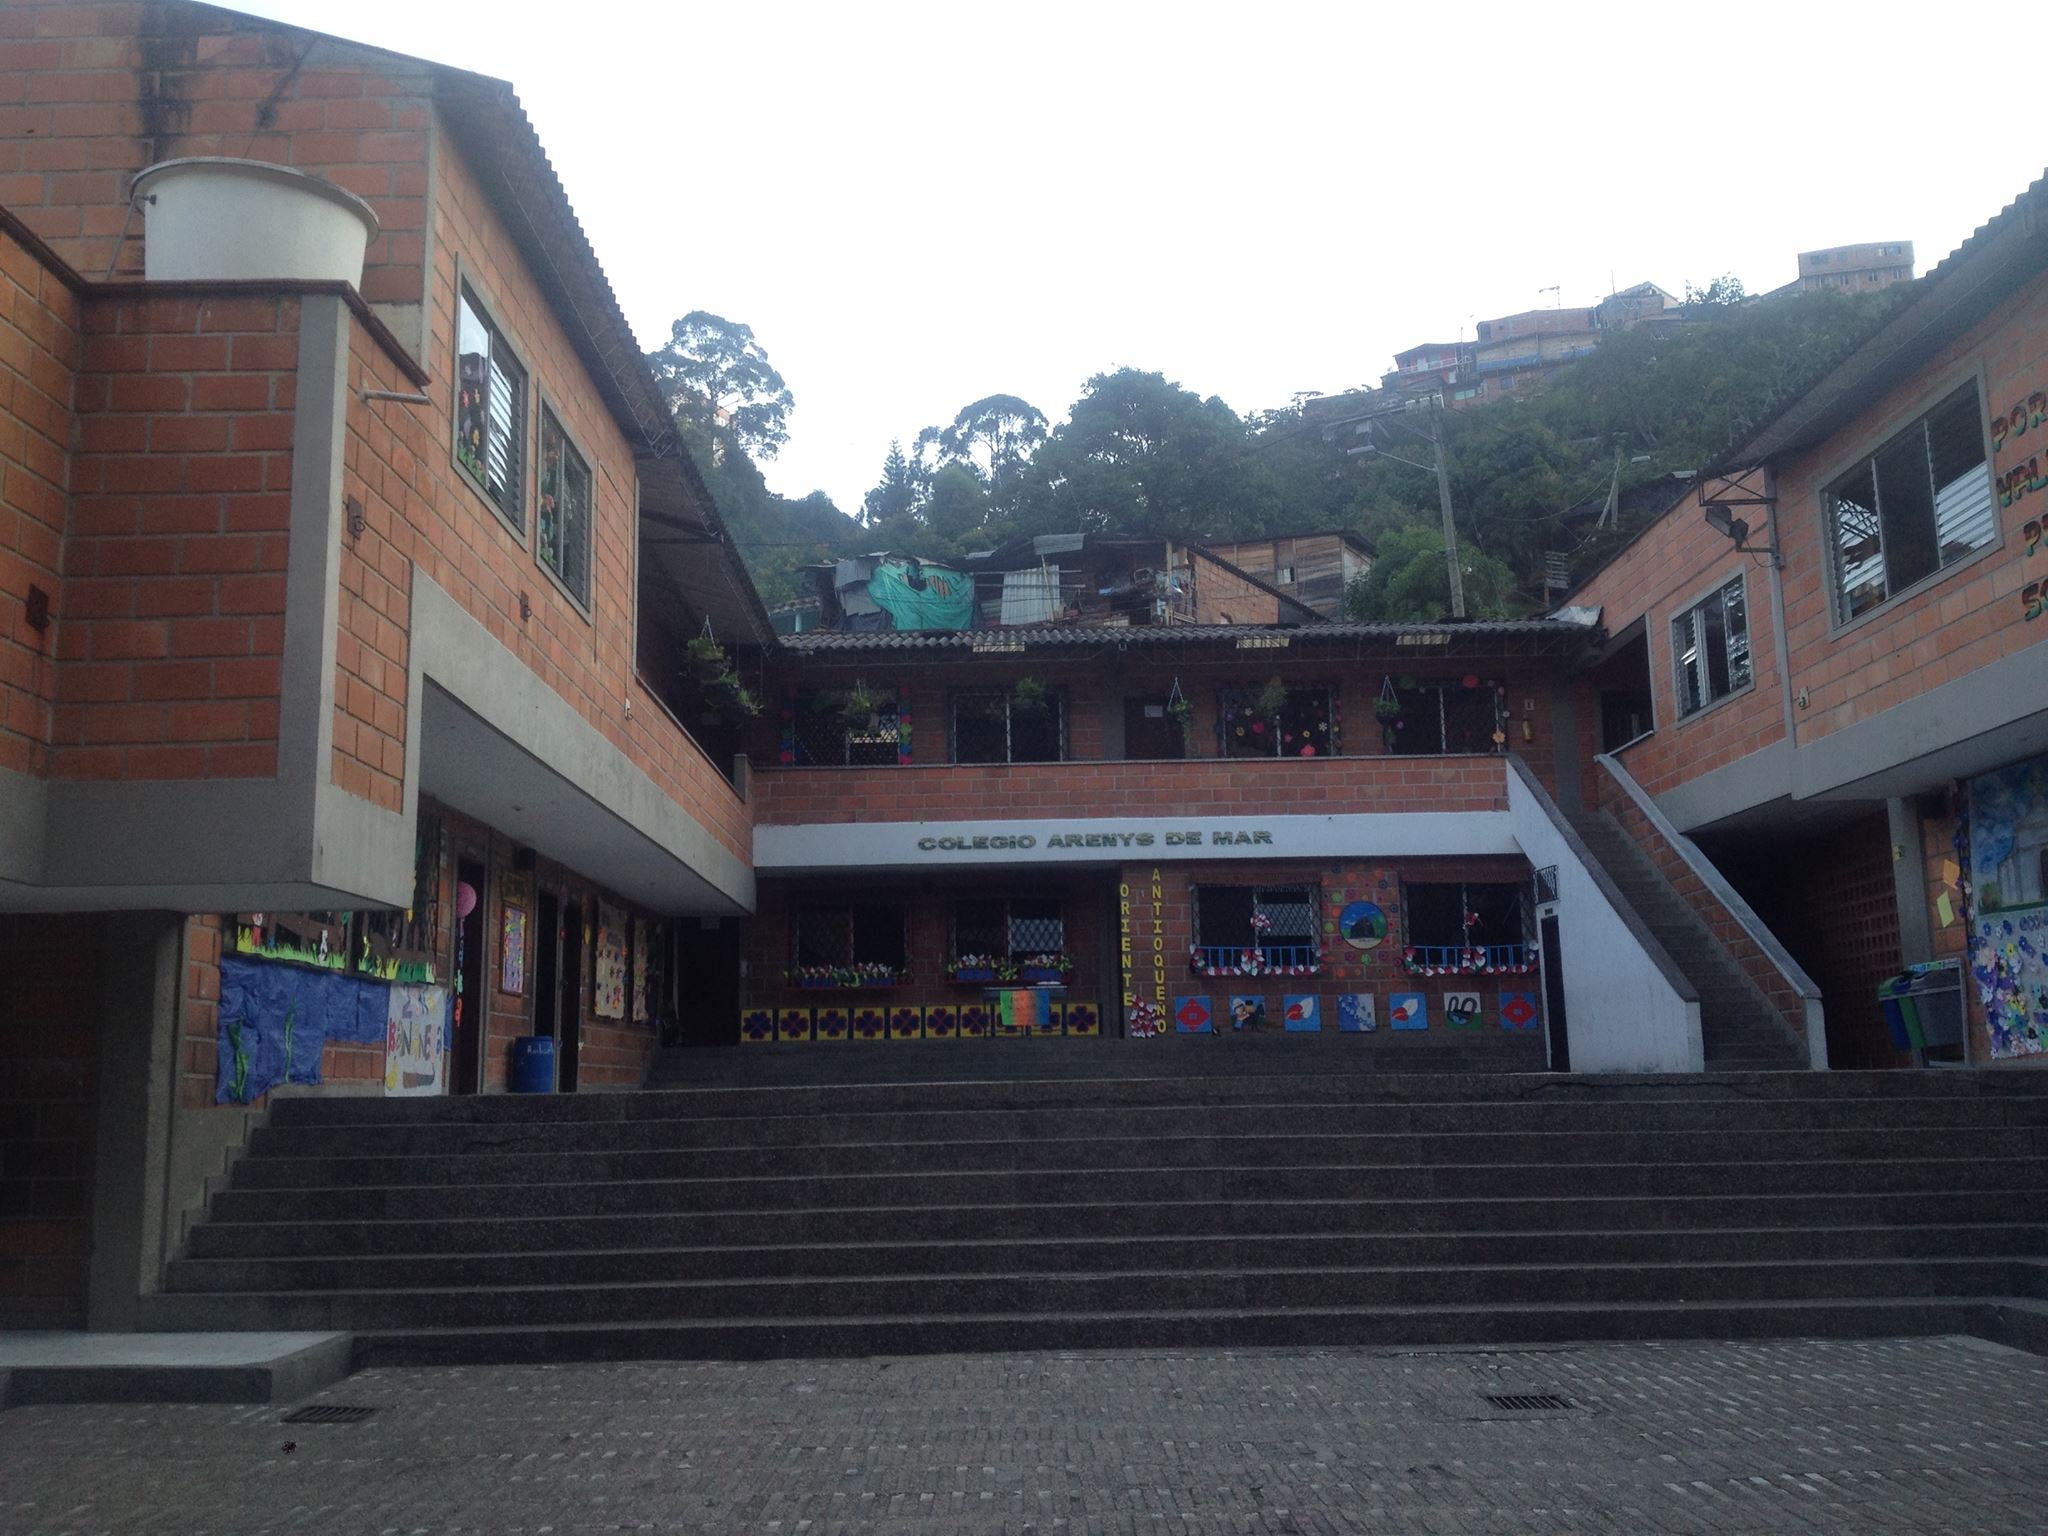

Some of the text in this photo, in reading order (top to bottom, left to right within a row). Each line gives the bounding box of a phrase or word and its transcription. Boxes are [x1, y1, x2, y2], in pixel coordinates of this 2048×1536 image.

[1991, 391, 2048, 452] POR
[1996, 448, 2048, 507] VAL
[917, 830, 1273, 852] COLEGIO ARENYS DE MAR
[1120, 883, 1134, 1007] ORIENTE
